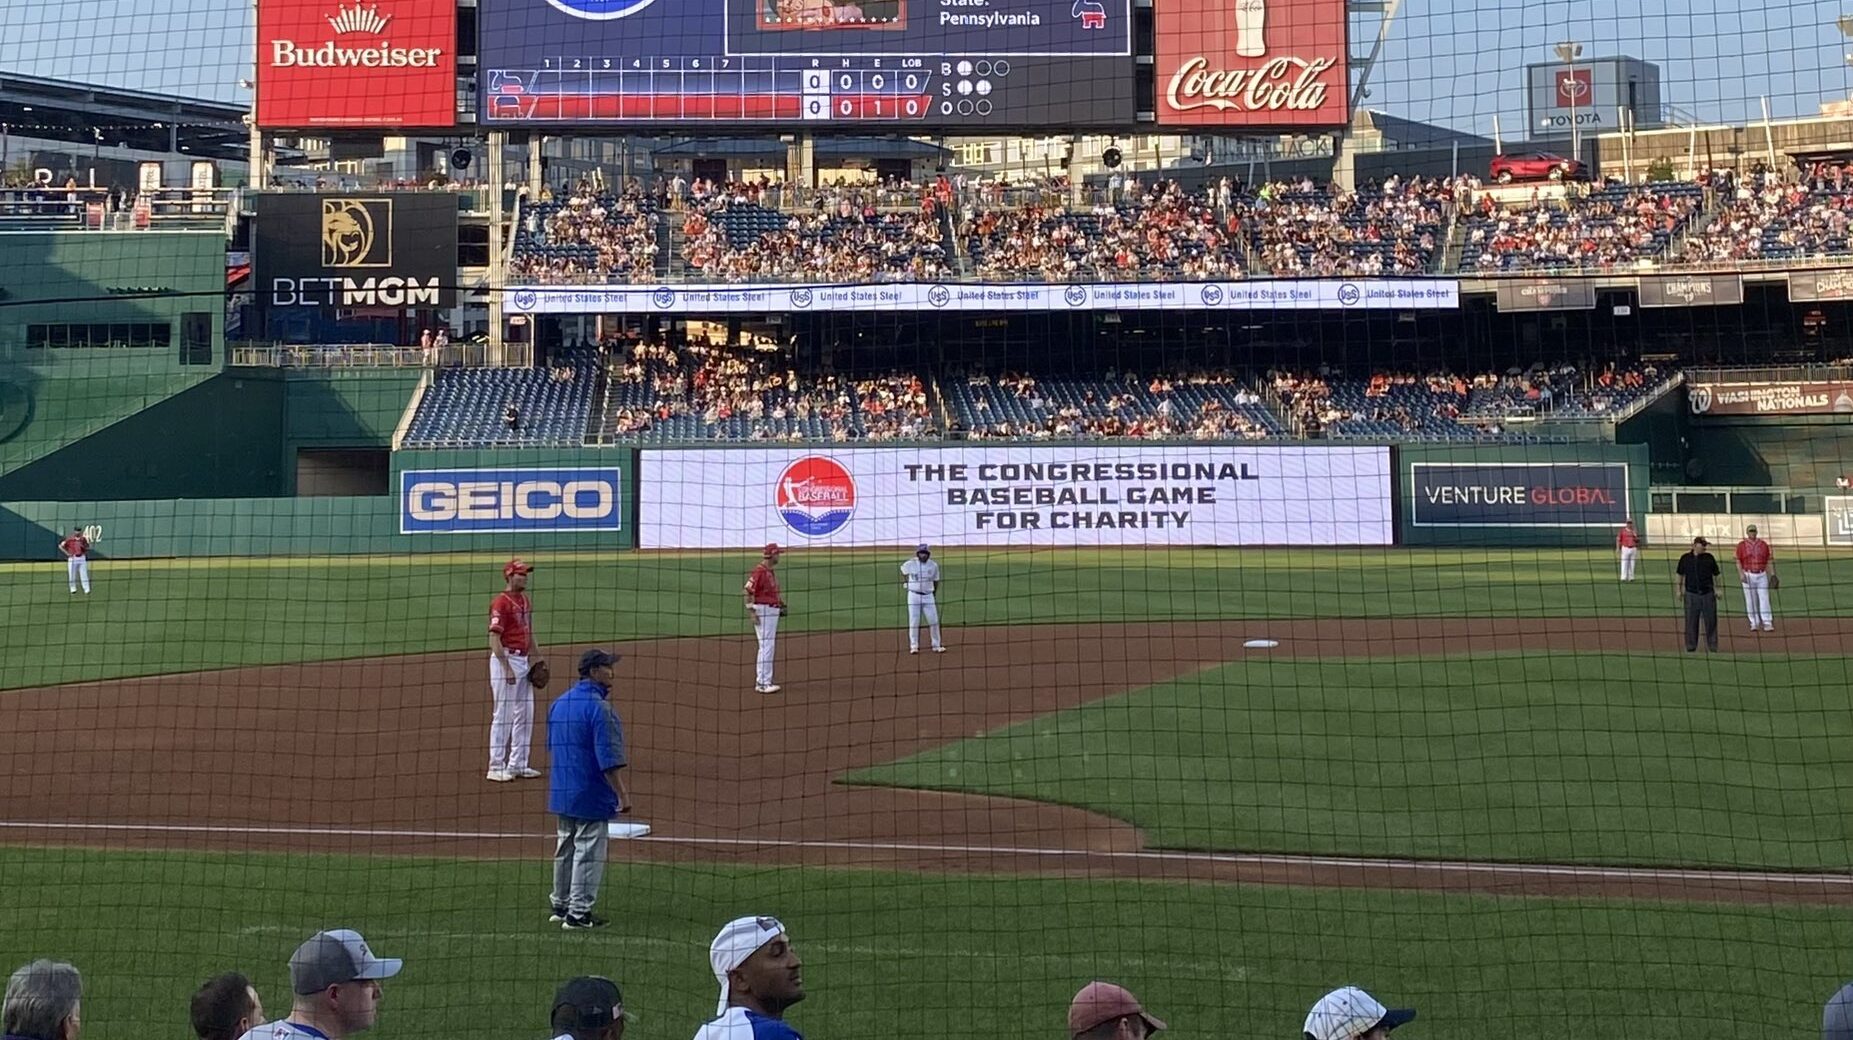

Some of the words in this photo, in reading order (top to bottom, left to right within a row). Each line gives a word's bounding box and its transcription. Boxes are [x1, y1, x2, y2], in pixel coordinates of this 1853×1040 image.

[940, 11, 1040, 28] Pennsylvania
[270, 39, 442, 67] Budweiser
[544, 59, 550, 68] 1
[573, 59, 581, 68] 2
[603, 59, 611, 68] 3
[633, 59, 641, 68] 4
[662, 59, 670, 68] 5
[692, 59, 700, 68] 6
[722, 59, 729, 68] 7
[811, 58, 819, 68] R
[842, 58, 850, 68] H
[874, 58, 881, 68] E
[902, 58, 922, 68] LOB
[941, 62, 951, 75] B
[810, 74, 820, 89] 0
[840, 74, 852, 89] 0
[872, 74, 884, 89] 0
[905, 74, 918, 89] 0
[1167, 56, 1337, 112] Coca-Cola
[942, 83, 951, 96] S
[810, 100, 820, 115] 0
[840, 100, 852, 115] 0
[873, 100, 881, 115] 1
[905, 100, 918, 115] 0
[1550, 113, 1602, 127] TOYOTA
[272, 277, 440, 306] BETMGM
[957, 290, 985, 300] United
[987, 290, 1014, 300] States
[1016, 290, 1039, 300] Steel
[1094, 290, 1122, 300] United
[1124, 290, 1150, 300] States
[1153, 290, 1175, 300] Steel
[1230, 289, 1258, 300] United
[1260, 289, 1287, 300] States
[1289, 289, 1312, 300] Steel
[1367, 288, 1395, 299] United
[1397, 288, 1425, 299] States
[1426, 288, 1449, 299] Steel
[1666, 281, 1712, 295] CHAMPIONS
[544, 293, 573, 303] United
[575, 293, 602, 303] States
[605, 293, 628, 303] Steel
[682, 292, 711, 302] United
[713, 292, 740, 302] States
[742, 292, 765, 302] Steel
[820, 291, 848, 301] United
[851, 291, 877, 301] States
[880, 291, 902, 301] Steel
[1717, 386, 1800, 404] WASHINGTON
[1757, 394, 1829, 412] NATIONALS
[904, 464, 967, 481] THE
[978, 463, 1259, 481] CONGRESSIONAL
[409, 480, 613, 521] GEICO
[947, 487, 1118, 505] BASEBALL
[1126, 487, 1216, 504] GAME
[1425, 486, 1525, 504] VENTURE
[1531, 486, 1616, 504] GLOBAL
[976, 512, 1041, 529] FOR
[1050, 511, 1190, 529] CHARITY
